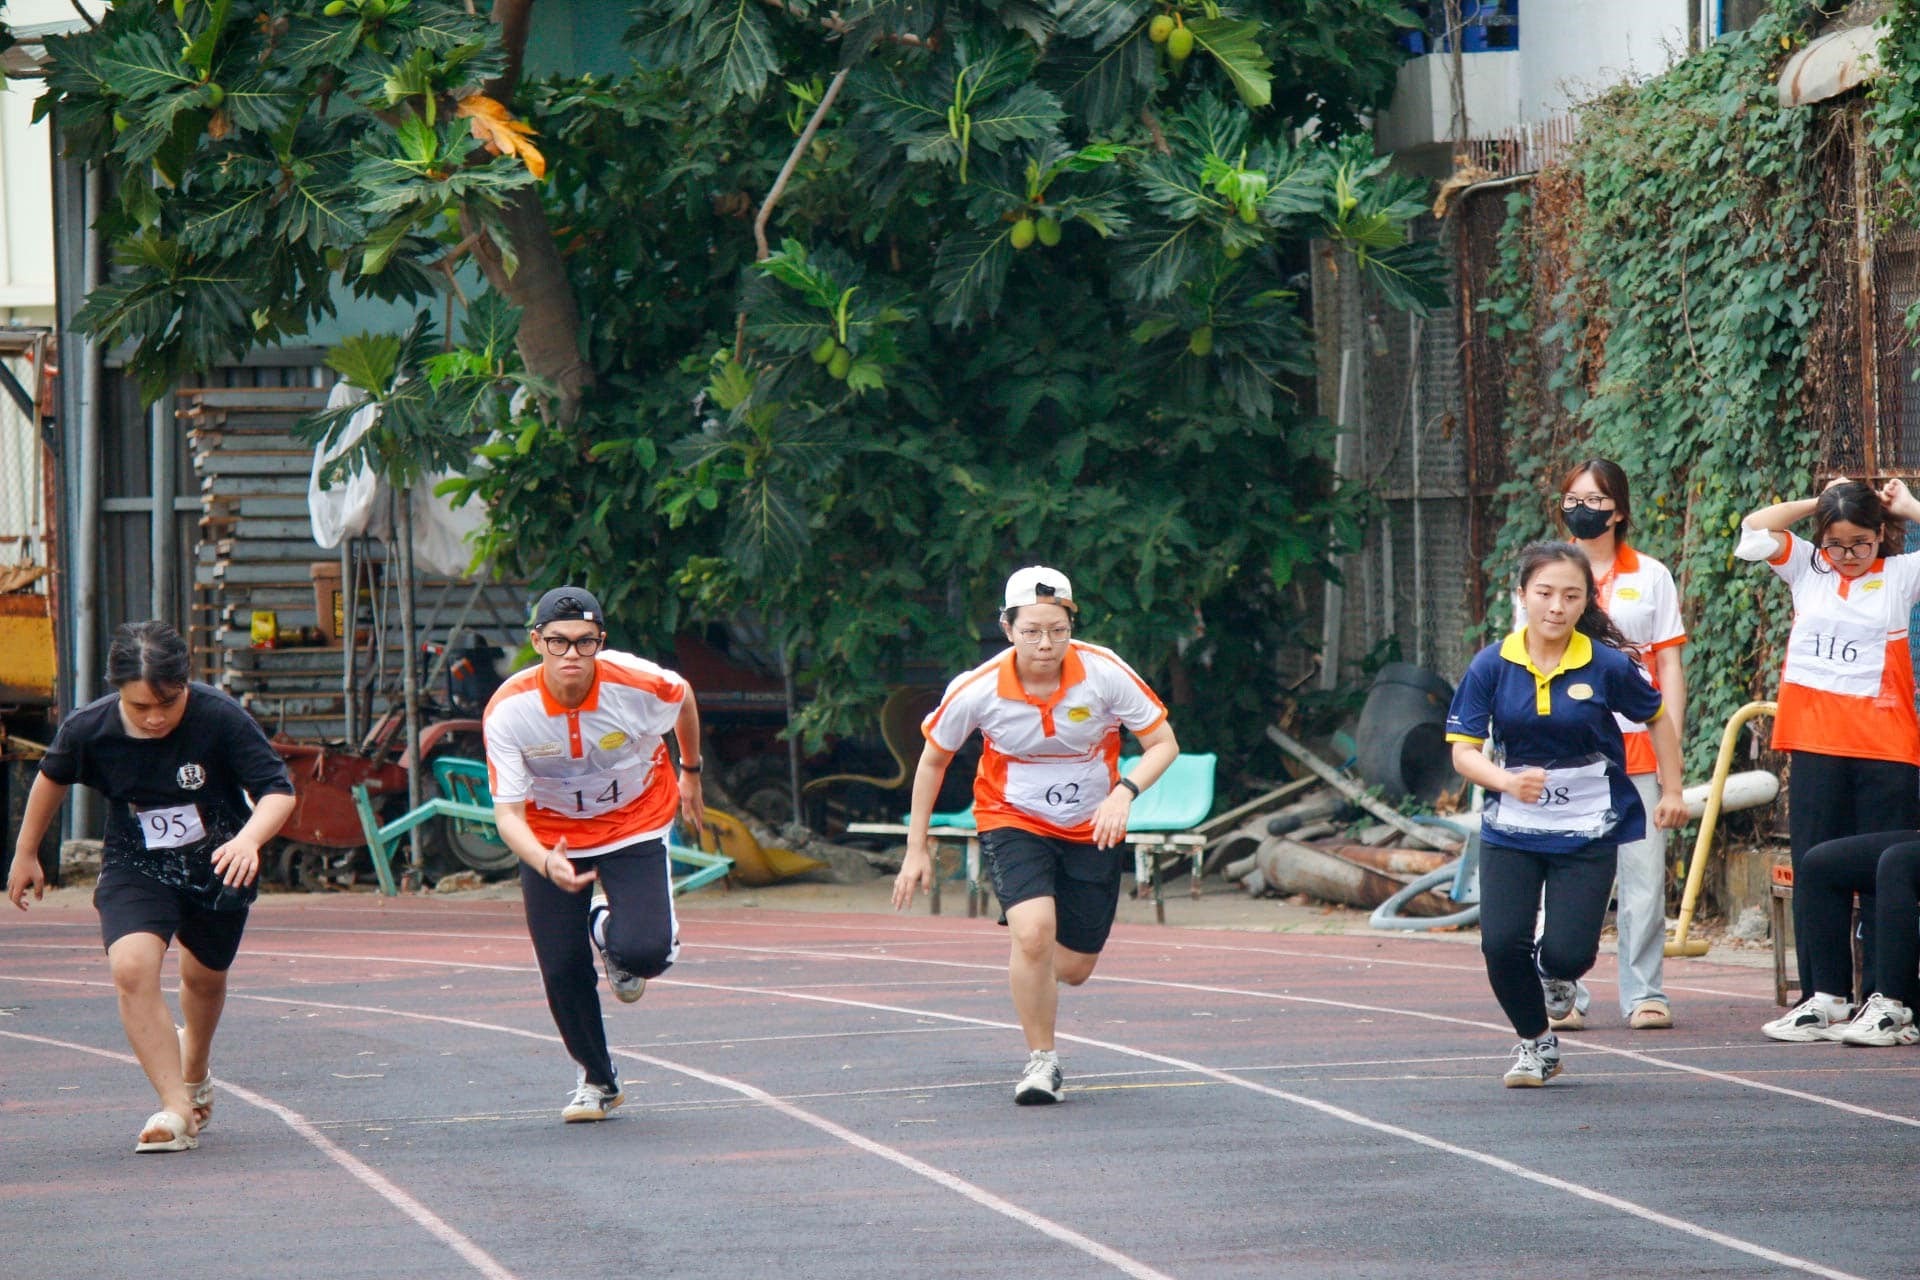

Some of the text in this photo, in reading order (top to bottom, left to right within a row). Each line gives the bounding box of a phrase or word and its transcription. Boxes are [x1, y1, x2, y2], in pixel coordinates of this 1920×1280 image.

[1814, 634, 1860, 663] 116
[569, 779, 623, 812] 14
[1046, 783, 1080, 806] 62
[151, 813, 187, 839] 95
